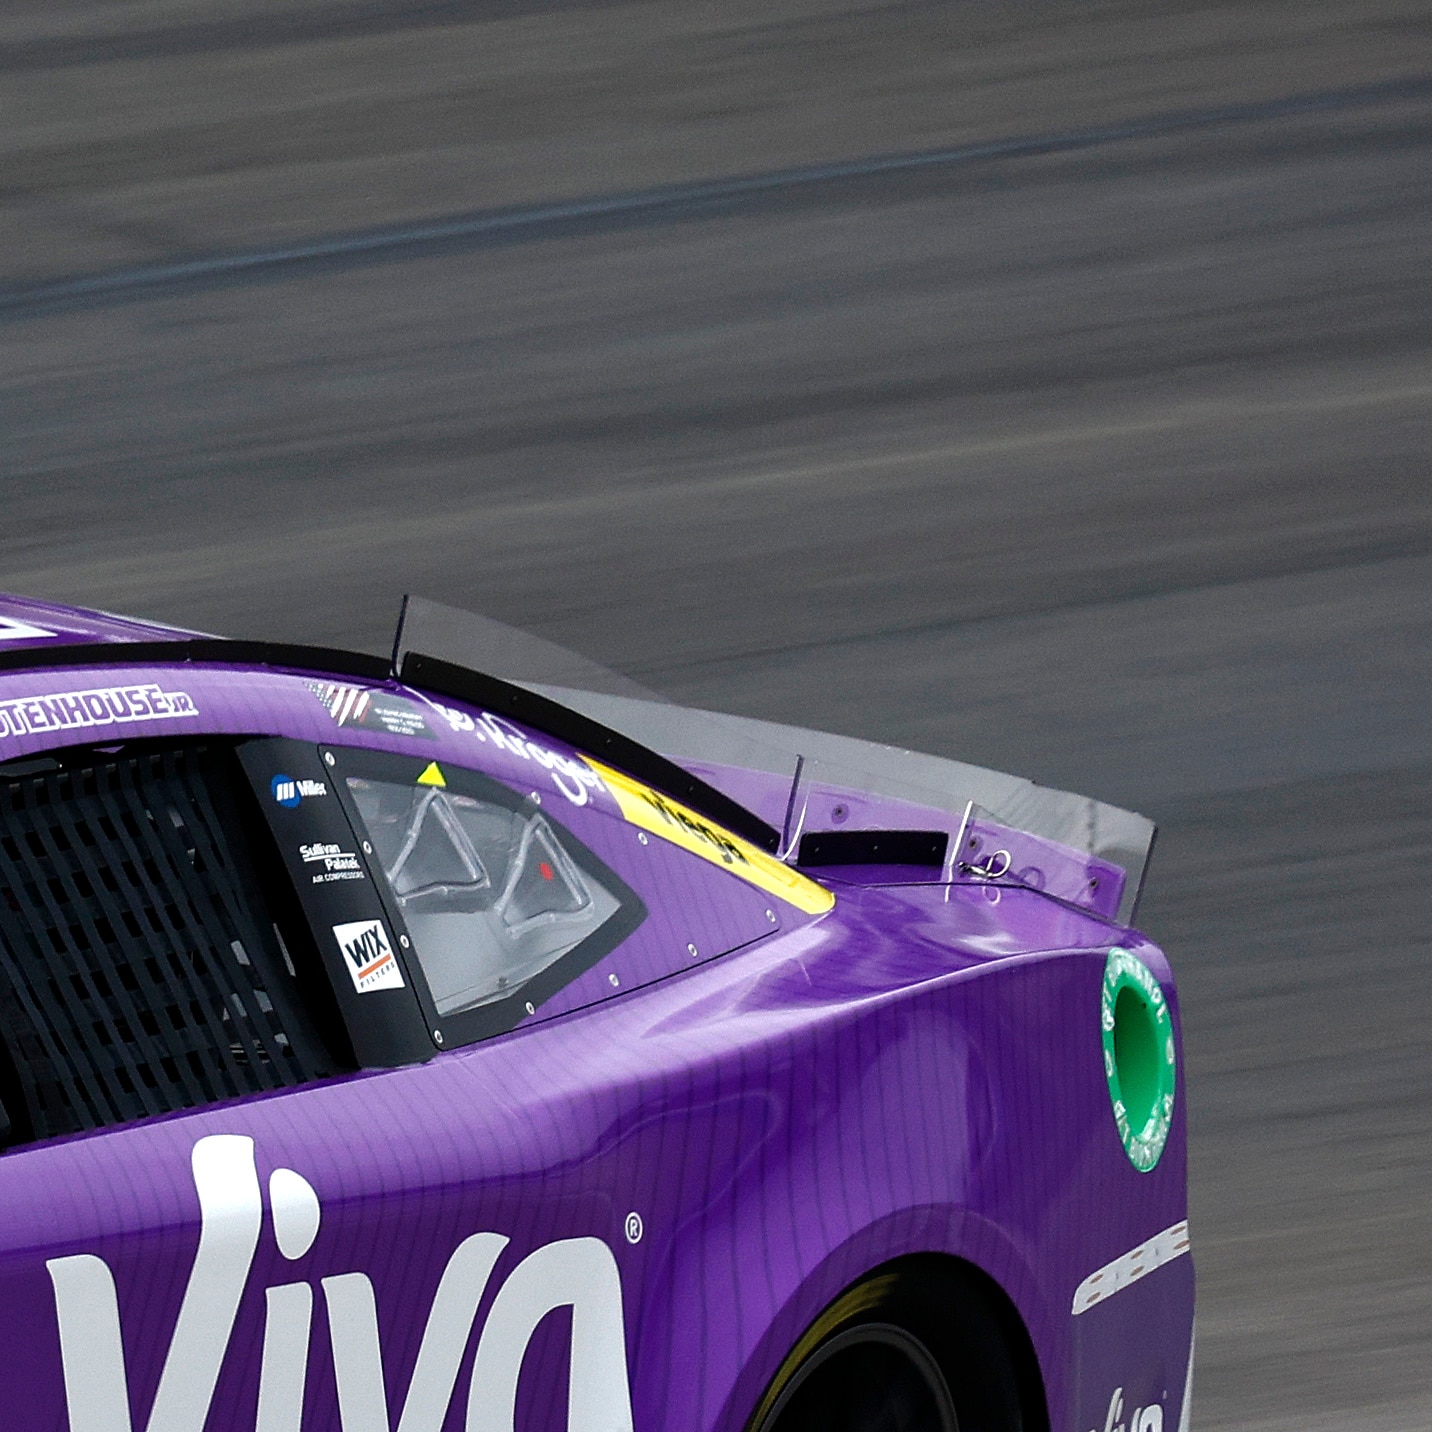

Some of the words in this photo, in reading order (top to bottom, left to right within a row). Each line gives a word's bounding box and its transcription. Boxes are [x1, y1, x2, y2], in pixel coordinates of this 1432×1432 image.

[299, 842, 341, 858] Sullivan
[325, 858, 360, 872] Palatek
[344, 924, 388, 969] WIX
[359, 961, 396, 989] FILTERS
